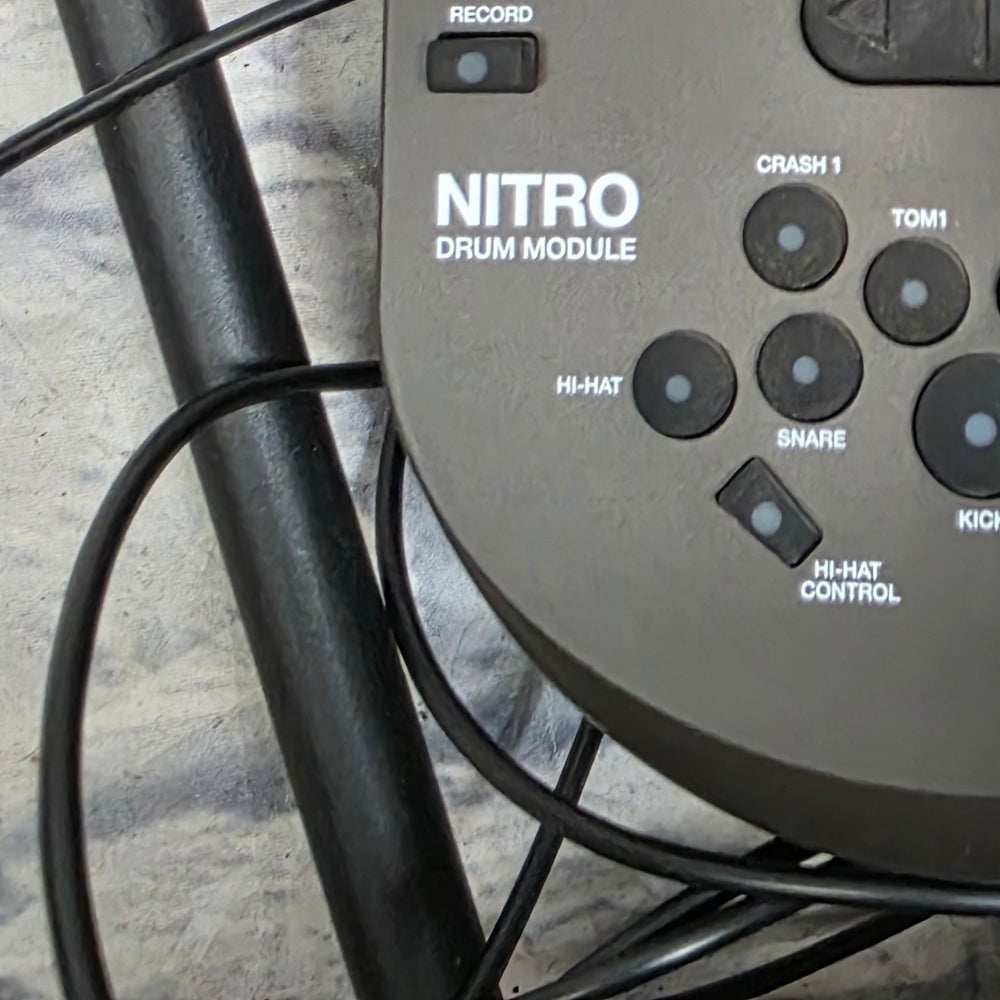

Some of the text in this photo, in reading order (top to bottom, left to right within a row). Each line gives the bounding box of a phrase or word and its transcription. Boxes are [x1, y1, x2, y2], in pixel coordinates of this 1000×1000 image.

[449, 5, 534, 25] RECORD
[756, 155, 842, 176] CRASH 1
[436, 172, 640, 229] NITRO
[892, 209, 949, 229] TOM1
[435, 236, 637, 262] DRUM MODULE
[556, 376, 623, 397] HI-HAT
[776, 429, 847, 450] SNARE
[814, 561, 881, 581] HI-HAT
[800, 581, 901, 604] CONTROL
